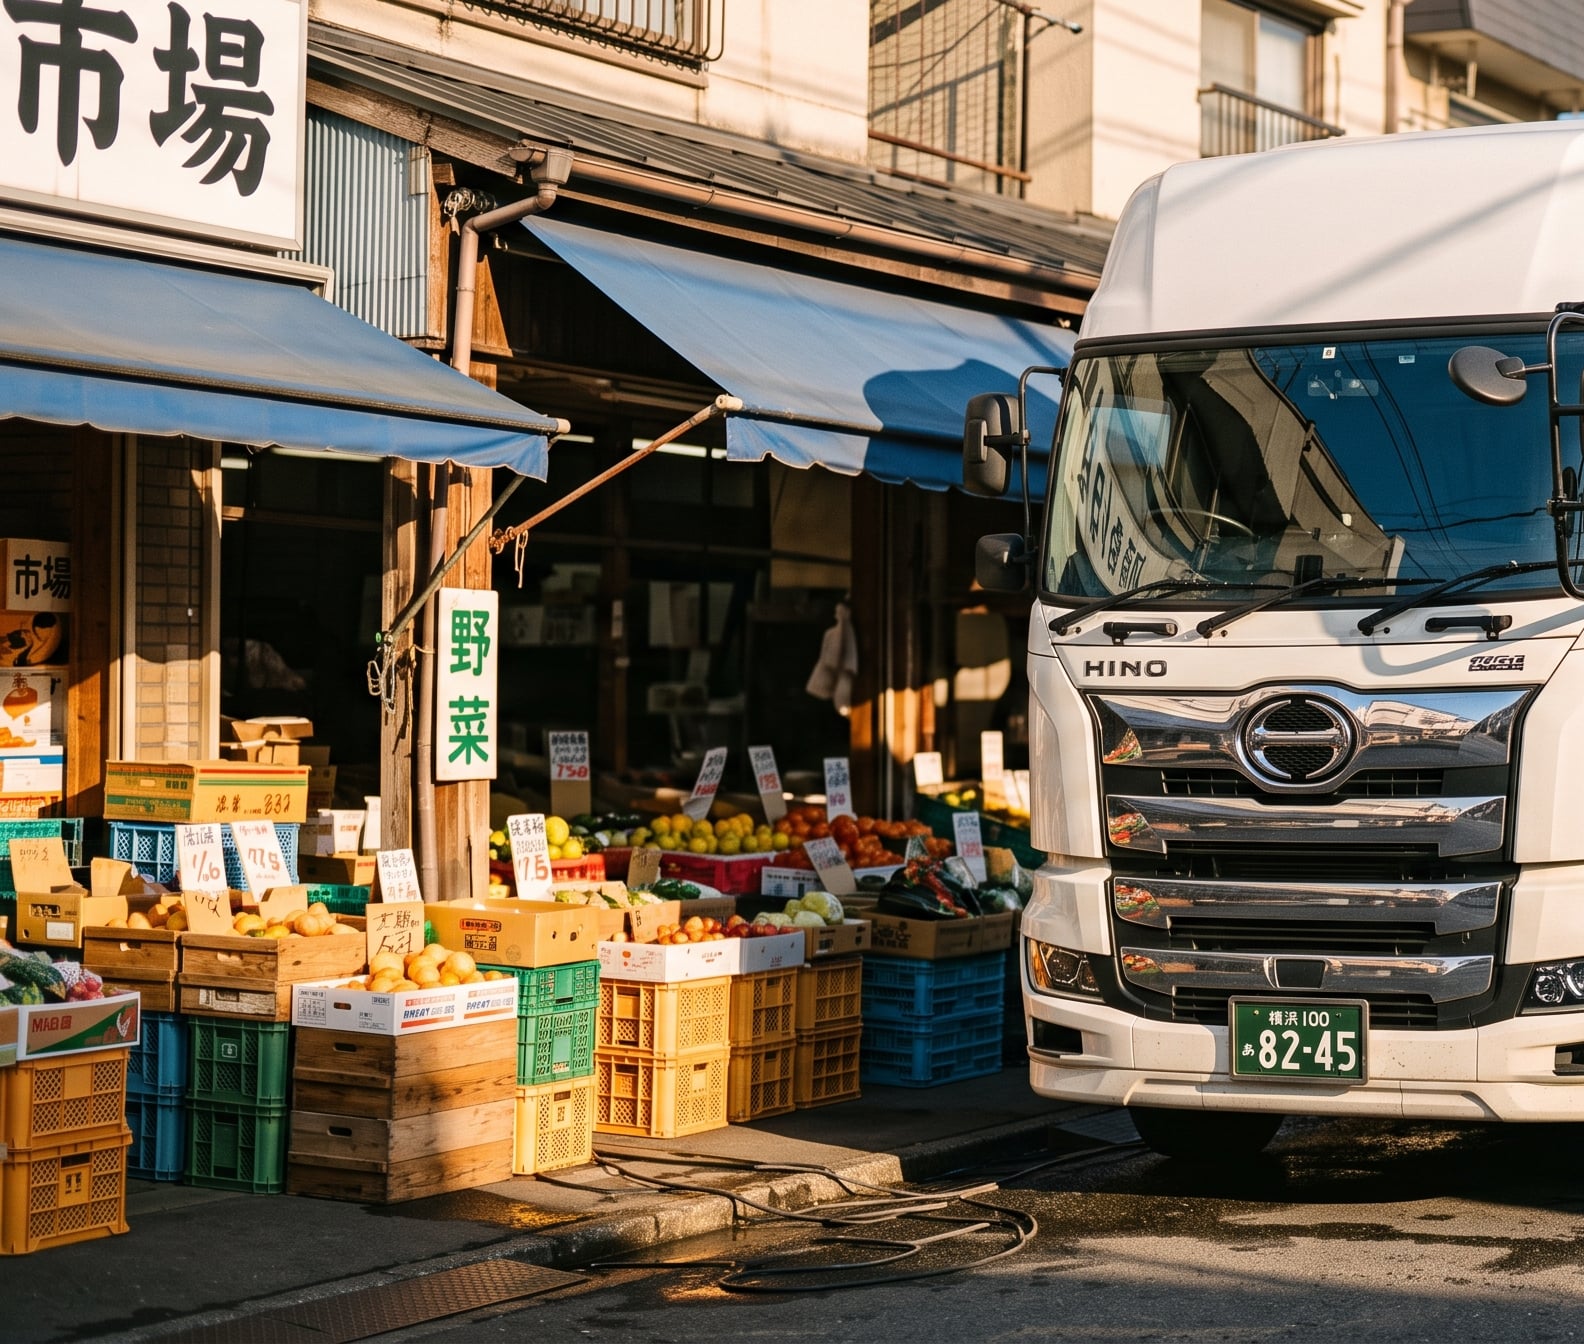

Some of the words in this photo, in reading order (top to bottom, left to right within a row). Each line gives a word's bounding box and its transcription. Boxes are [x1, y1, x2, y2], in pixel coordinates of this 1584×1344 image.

[4, 0, 275, 197] 市場
[14, 554, 71, 599] 市場
[448, 610, 490, 765] 野菜
[1084, 660, 1167, 677] HINO
[1303, 1011, 1330, 1027] 100
[1242, 1043, 1255, 1056] あ
[1259, 1029, 1356, 1071] 82-45
